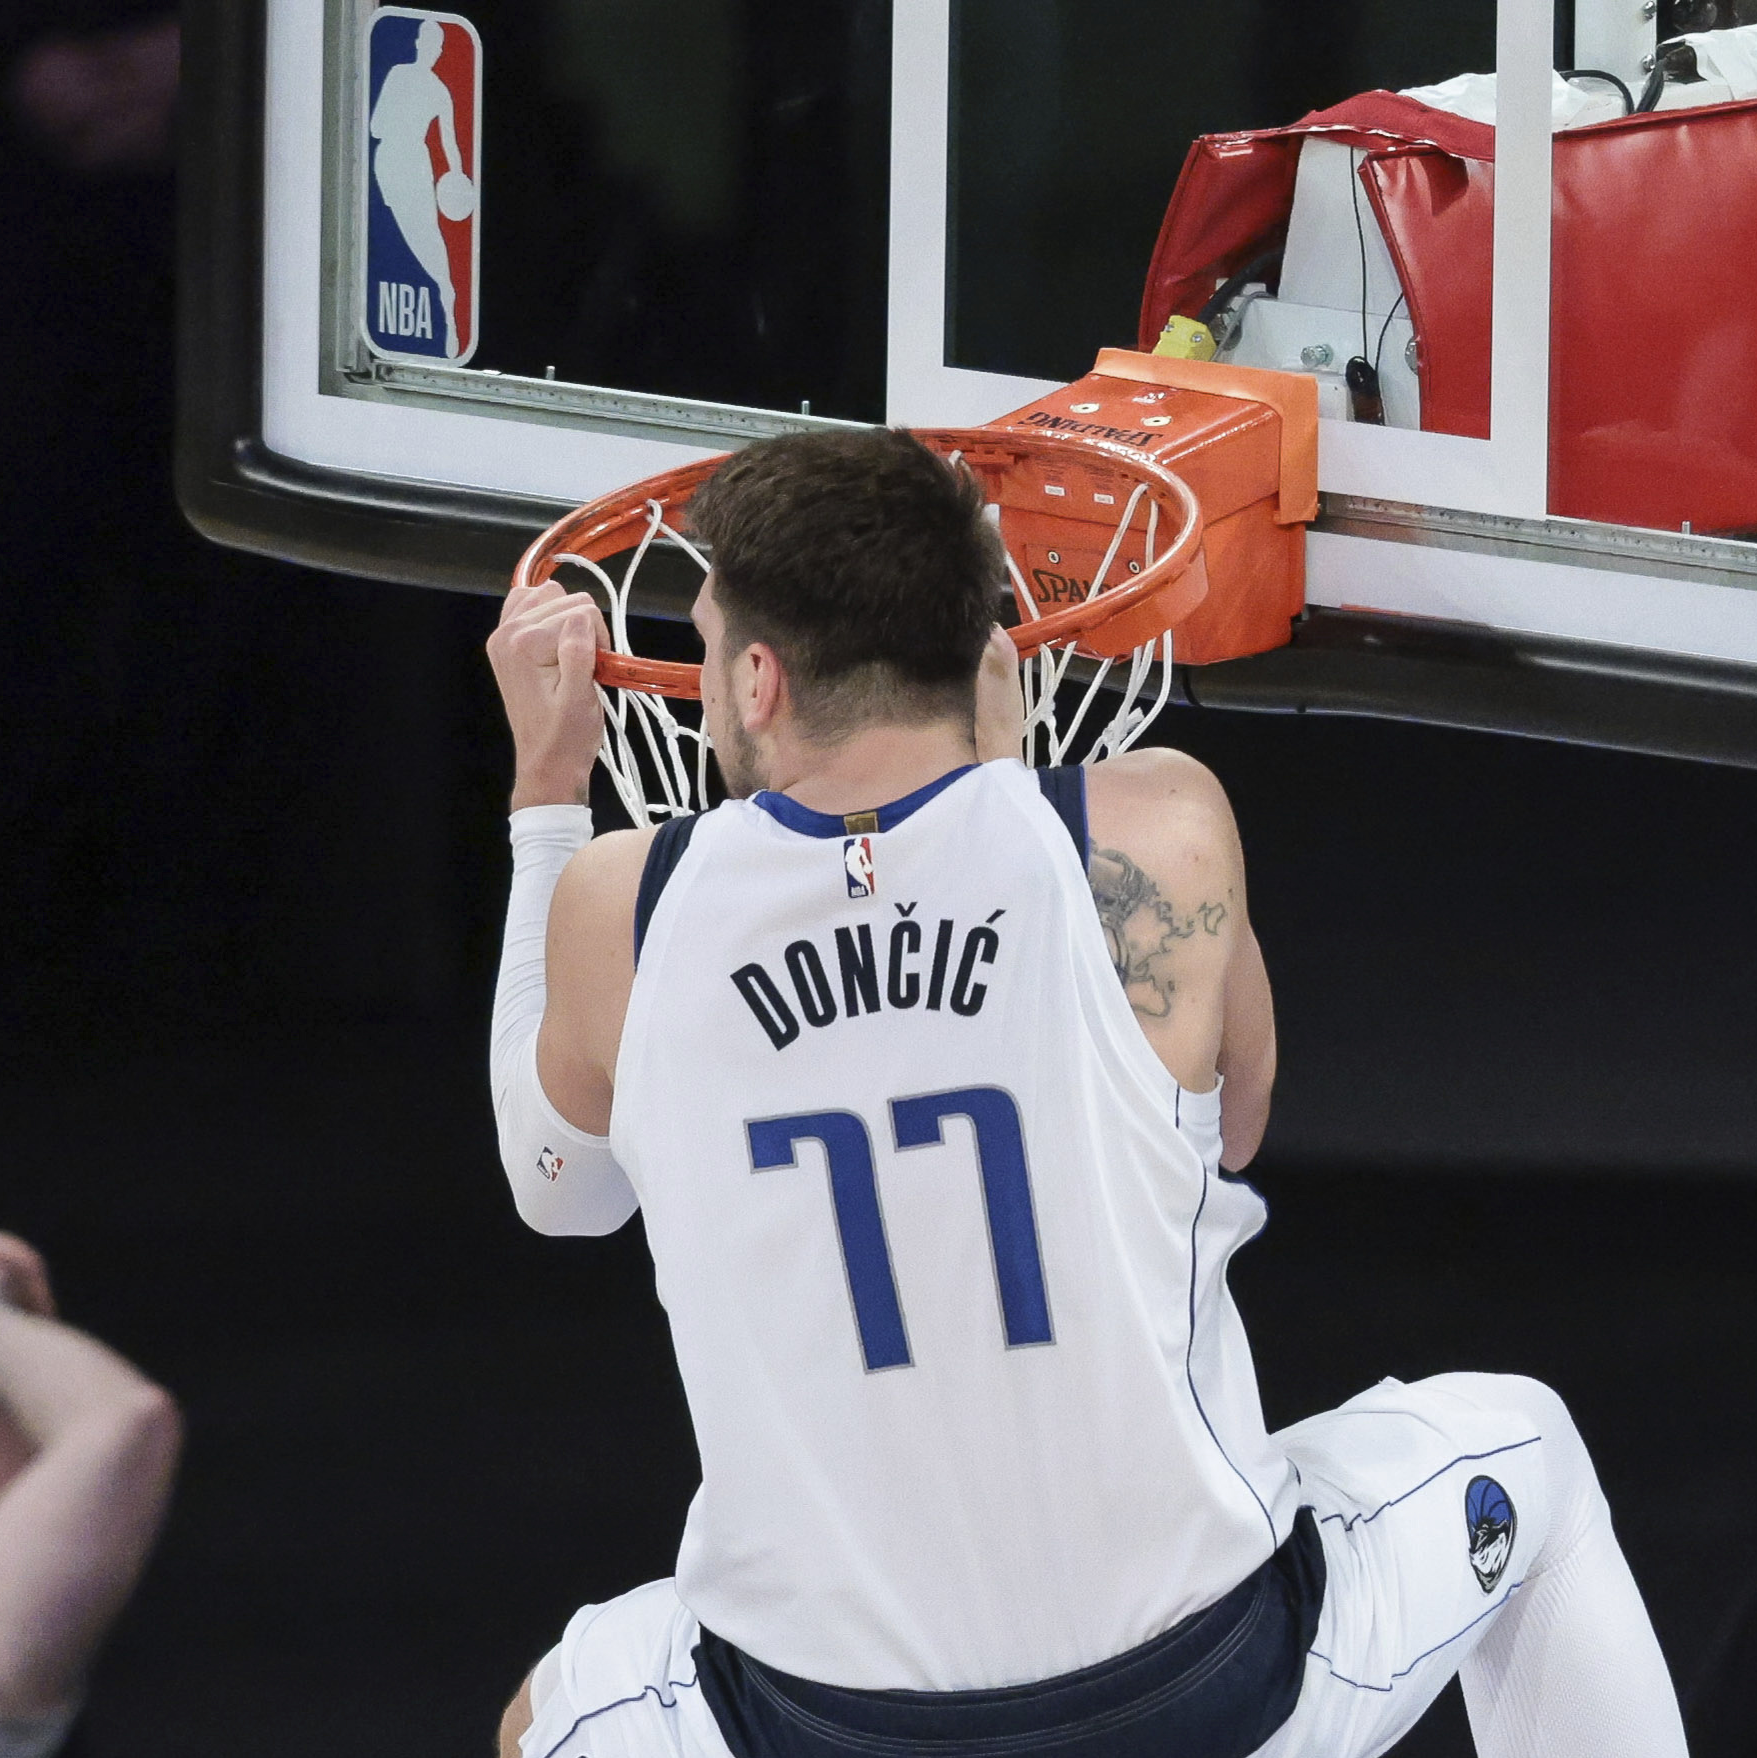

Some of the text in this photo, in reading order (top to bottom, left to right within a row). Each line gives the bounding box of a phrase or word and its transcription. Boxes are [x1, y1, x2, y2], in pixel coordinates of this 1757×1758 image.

[378, 280, 433, 340] NBA
[730, 901, 1006, 1051] DONČIĆ
[743, 1083, 1056, 1375] 77
